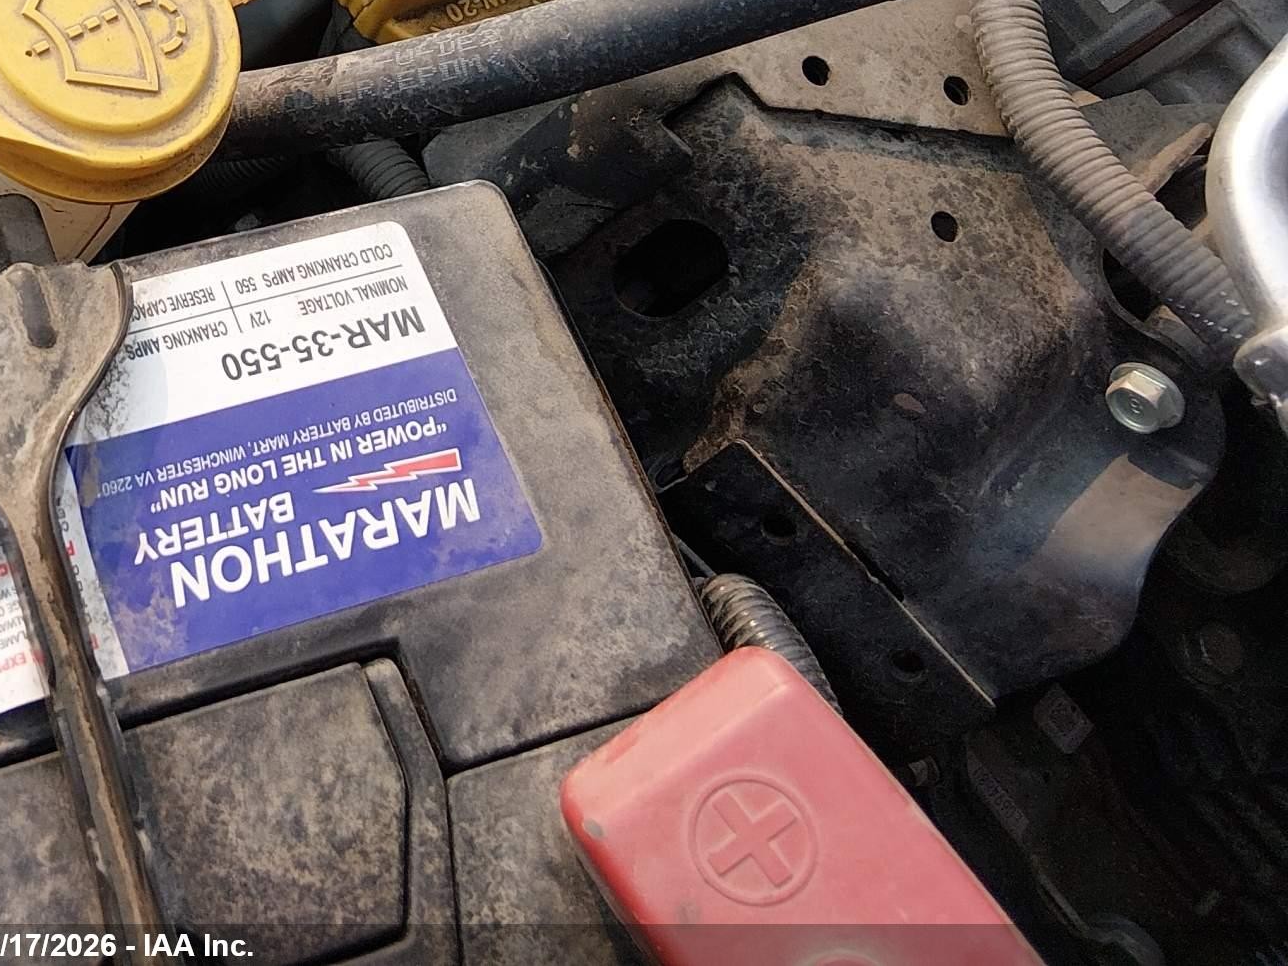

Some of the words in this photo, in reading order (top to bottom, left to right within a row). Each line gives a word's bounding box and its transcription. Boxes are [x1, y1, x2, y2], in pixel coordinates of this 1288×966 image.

[295, 250, 359, 280] CRANKING
[357, 241, 393, 264] COLD
[233, 275, 257, 295] 550
[260, 266, 296, 288] AMPS
[351, 273, 408, 303] NOMINAL
[165, 285, 215, 312] RESERVE
[296, 287, 353, 316] VOLTAGE
[247, 307, 272, 328] 12V
[123, 335, 162, 361] AMPS
[161, 319, 229, 351] CRANKING
[220, 303, 425, 382] MAR-35-550
[351, 410, 372, 428] BY
[370, 386, 458, 423] DISTRIBUTED
[246, 431, 290, 457] MART,
[289, 415, 352, 445] BATTERY
[150, 444, 246, 483] WINCHESTER
[279, 445, 327, 476] THE
[327, 437, 354, 462] IN
[134, 470, 154, 488] VA
[211, 458, 279, 495] LONG
[127, 489, 297, 565] BATTERY
[163, 476, 483, 608] MARATHON
